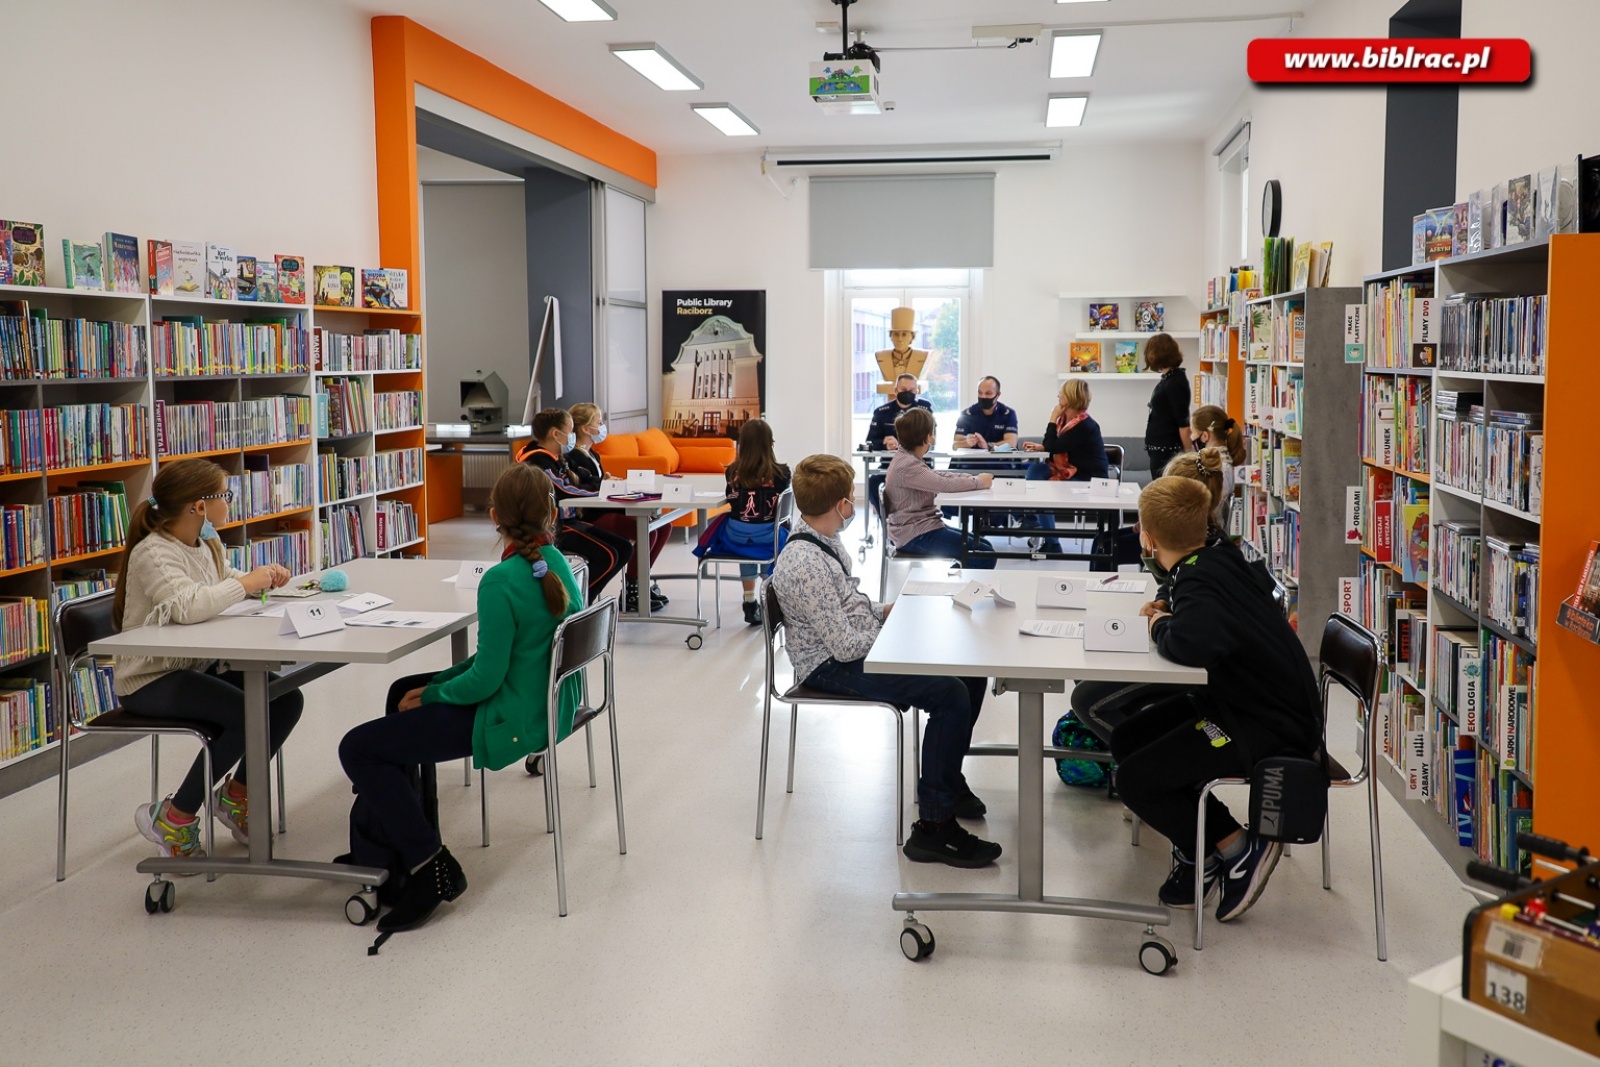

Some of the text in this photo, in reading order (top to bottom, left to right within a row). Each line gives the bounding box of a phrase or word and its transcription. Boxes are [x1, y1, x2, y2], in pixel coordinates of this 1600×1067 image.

[677, 298, 733, 308] Public Library
[677, 307, 713, 315] Raciborz
[1421, 300, 1430, 342] FILMY DVD
[1353, 490, 1361, 526] ORIGAMI
[1060, 584, 1067, 592] 9
[1344, 580, 1352, 614] SPORT
[309, 608, 322, 617] 11
[1111, 622, 1119, 631] 6
[1467, 680, 1476, 733] EKOLOGIA
[1508, 686, 1516, 734] NARODOWE
[1262, 766, 1285, 810] PUMA
[1409, 773, 1417, 790] GRY
[1489, 981, 1526, 1011] 138
